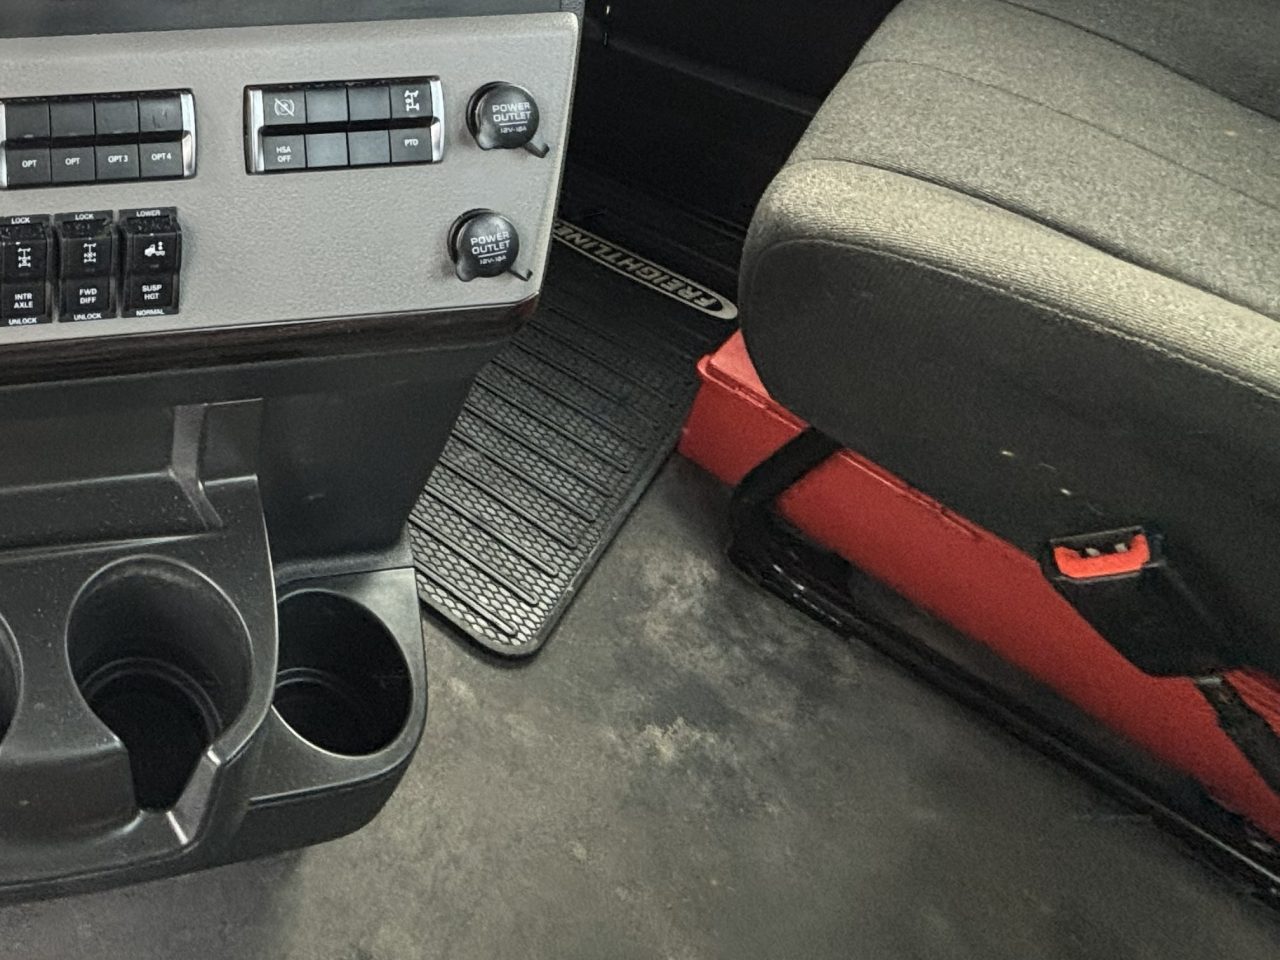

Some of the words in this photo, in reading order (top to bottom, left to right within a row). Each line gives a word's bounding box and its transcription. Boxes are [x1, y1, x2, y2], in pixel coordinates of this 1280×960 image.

[492, 102, 530, 113] POWER
[493, 111, 531, 123] OUTLET
[404, 138, 419, 147] PTO
[276, 146, 291, 154] HSA
[108, 155, 123, 164] OPT
[151, 153, 166, 161] OPT
[277, 155, 291, 163] OFF
[22, 159, 37, 168] OPT
[65, 157, 81, 166] OPT
[74, 213, 95, 221] LOCK
[136, 209, 161, 217] LOWER
[11, 217, 31, 225] LOCK
[470, 231, 510, 246] POWER
[471, 240, 511, 255] OUTLET
[554, 222, 719, 308] FREIGHTLINE
[79, 288, 97, 296] FWD
[142, 284, 162, 293] SUSP
[14, 292, 33, 300] INTR
[80, 296, 97, 304] DIFF
[144, 292, 160, 300] HGT
[13, 301, 34, 309] AXLE
[136, 308, 165, 317] NORMAL
[73, 313, 102, 321] UNLOCK
[8, 317, 38, 326] UNLOCK
